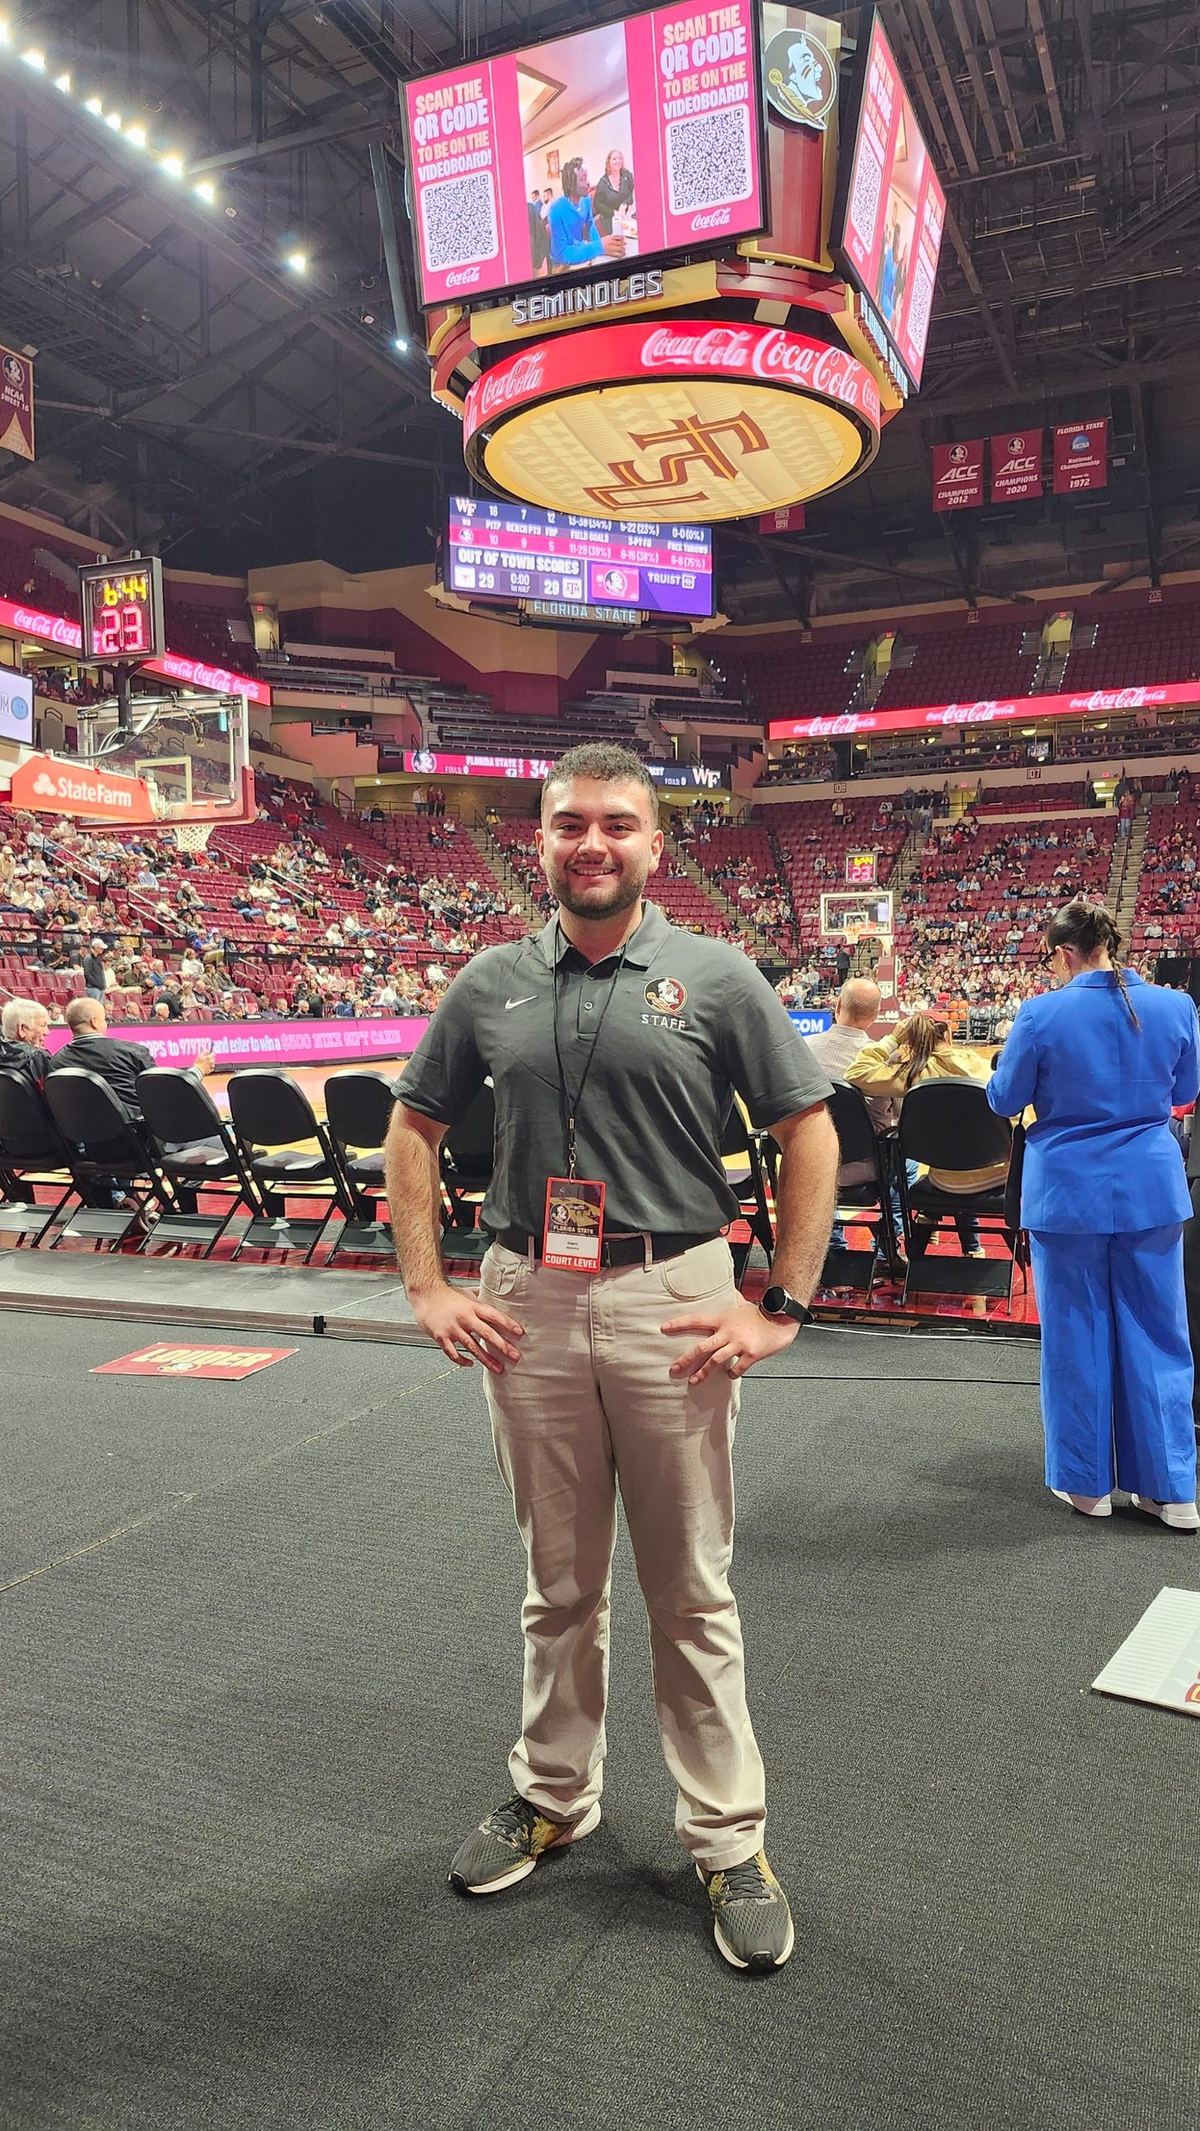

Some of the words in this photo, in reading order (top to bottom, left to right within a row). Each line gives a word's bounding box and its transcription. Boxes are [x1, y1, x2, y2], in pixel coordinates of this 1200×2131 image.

[663, 14, 706, 46] SCAN
[708, 4, 740, 33] THE
[660, 44, 689, 79] QR
[692, 26, 747, 67] CODE
[663, 79, 681, 99] TO
[682, 73, 699, 94] BE
[701, 68, 719, 89] ON
[720, 60, 747, 83] THE
[416, 87, 454, 115] SCAN
[454, 78, 483, 103] THE
[663, 81, 749, 120] VIDEOBOARD!
[414, 113, 439, 146] QR
[441, 98, 489, 135] CODE
[418, 146, 433, 163] TO
[434, 142, 449, 159] BE
[449, 136, 466, 155] ON
[467, 130, 490, 150] THE
[418, 149, 492, 183] VIDEOBOARD!
[512, 269, 663, 325] SEMINOLES
[1, 393, 20, 407] SWEET
[22, 403, 30, 412] 16
[5, 385, 24, 402] NCAA
[1057, 425, 1084, 435] FLORIDA
[1085, 421, 1104, 431] STATE
[1072, 442, 1090, 450] NCAA
[940, 465, 981, 480] ACC
[999, 456, 1038, 473] ACC
[995, 474, 1038, 487] CHAMPIONS
[1006, 485, 1027, 494] 2020
[1069, 478, 1090, 488] 1972
[938, 488, 978, 499] CHAMPIONS
[948, 495, 968, 505] 2012
[521, 509, 527, 520] 7
[547, 512, 556, 524] 12
[489, 534, 499, 545] 10
[521, 537, 528, 549] 9
[458, 548, 482, 565] OUT
[483, 551, 499, 567] OF
[500, 553, 535, 571] TOWN
[536, 558, 580, 576] SCORES
[479, 572, 495, 589] 29
[510, 572, 530, 586] 0:00
[544, 580, 560, 596] 29
[647, 572, 682, 586] TRUIST
[533, 602, 588, 617] FLORIDA
[595, 607, 636, 622] STATE
[100, 606, 143, 653] 23
[465, 755, 494, 766] FLORIDA
[494, 757, 517, 768] STATE
[529, 760, 549, 778] 34
[641, 1013, 687, 1030] STAFF
[168, 1038, 179, 1056] to
[213, 1036, 229, 1054] and
[274, 1037, 281, 1051] a
[553, 1224, 576, 1233] FLORIDA
[545, 1254, 572, 1266] COURT
[573, 1257, 598, 1269] LEVEL
[130, 1348, 274, 1368] LOUDER
